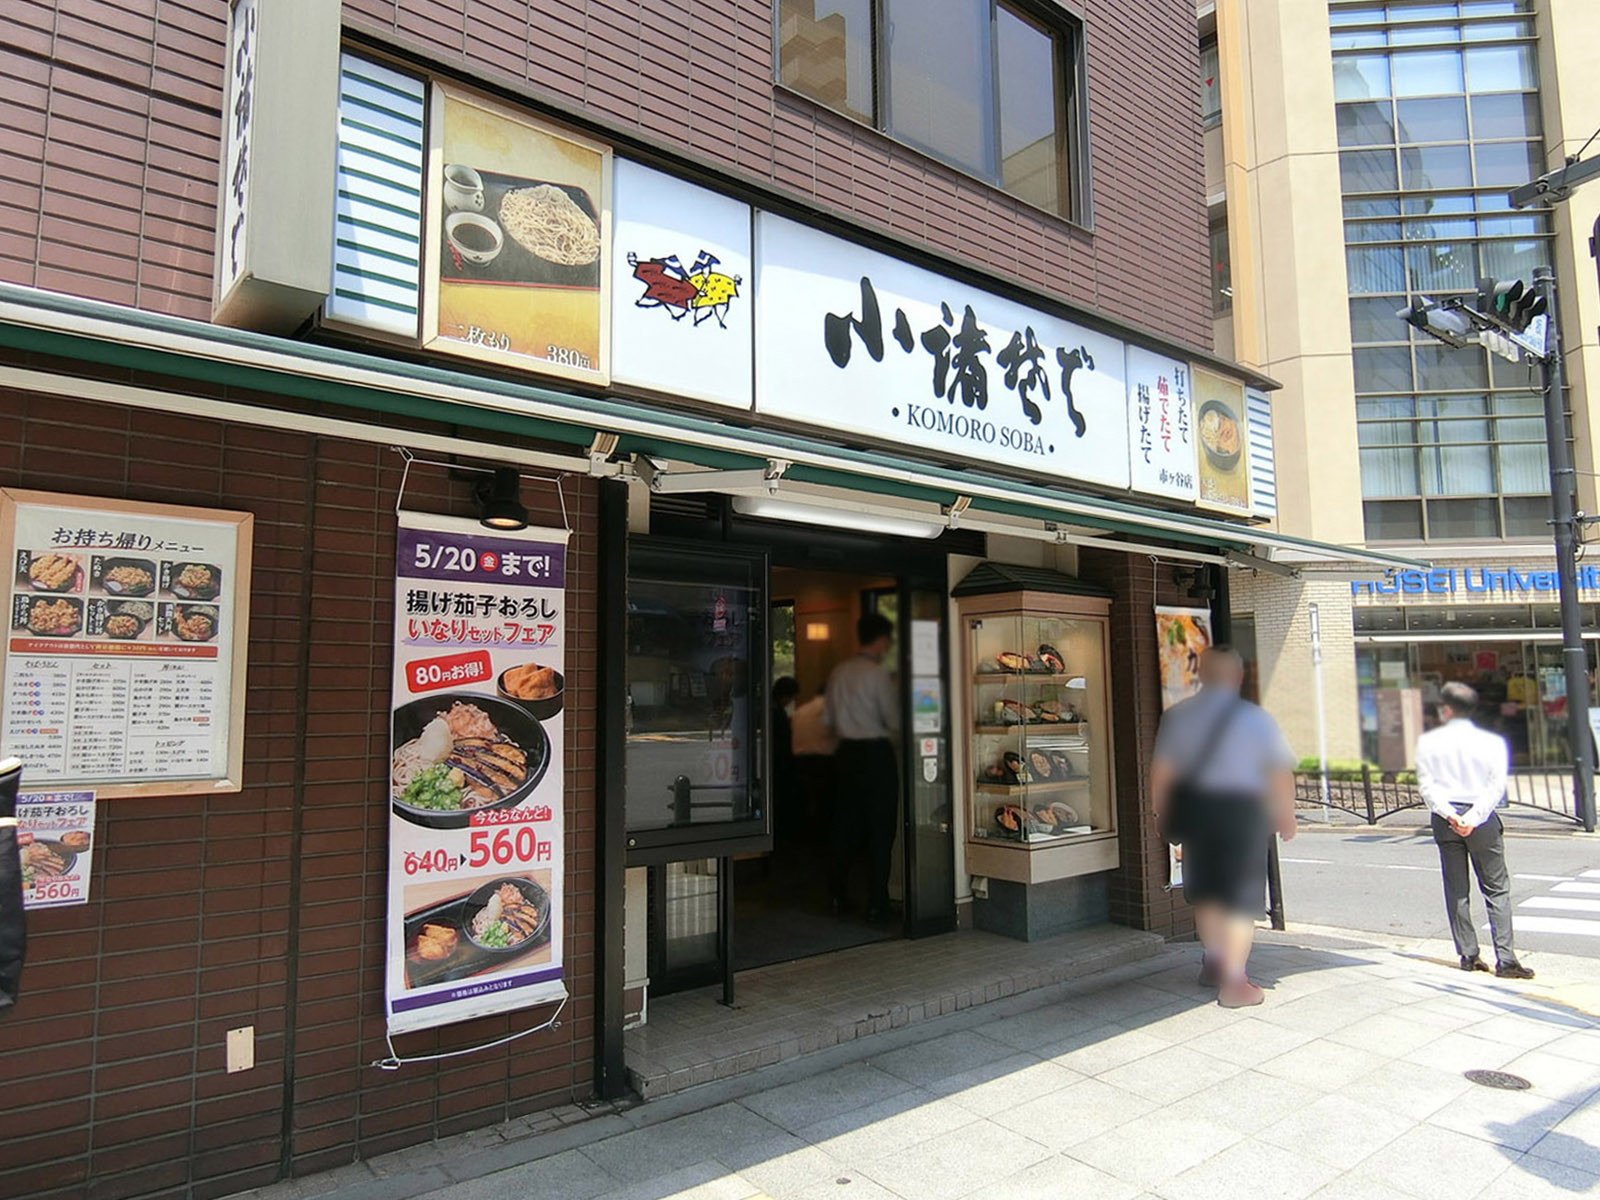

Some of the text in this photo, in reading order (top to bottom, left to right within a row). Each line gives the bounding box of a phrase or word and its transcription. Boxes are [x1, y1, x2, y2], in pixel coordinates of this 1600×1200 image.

[547, 344, 590, 369] 380円
[1157, 375, 1171, 453] 茹でたて
[1174, 367, 1188, 444] 打ちたて
[906, 403, 1045, 456] KOMORO SOBA
[1137, 382, 1152, 464] 揚げたて
[51, 527, 205, 552] お持ち帰りメニュー
[406, 589, 557, 618] 揚げ茄子おろし
[408, 618, 554, 644] いなりセットフェア
[18, 805, 88, 818] げ茄子おろし
[404, 827, 552, 875] 640円 560円
[35, 883, 79, 900] 560円
